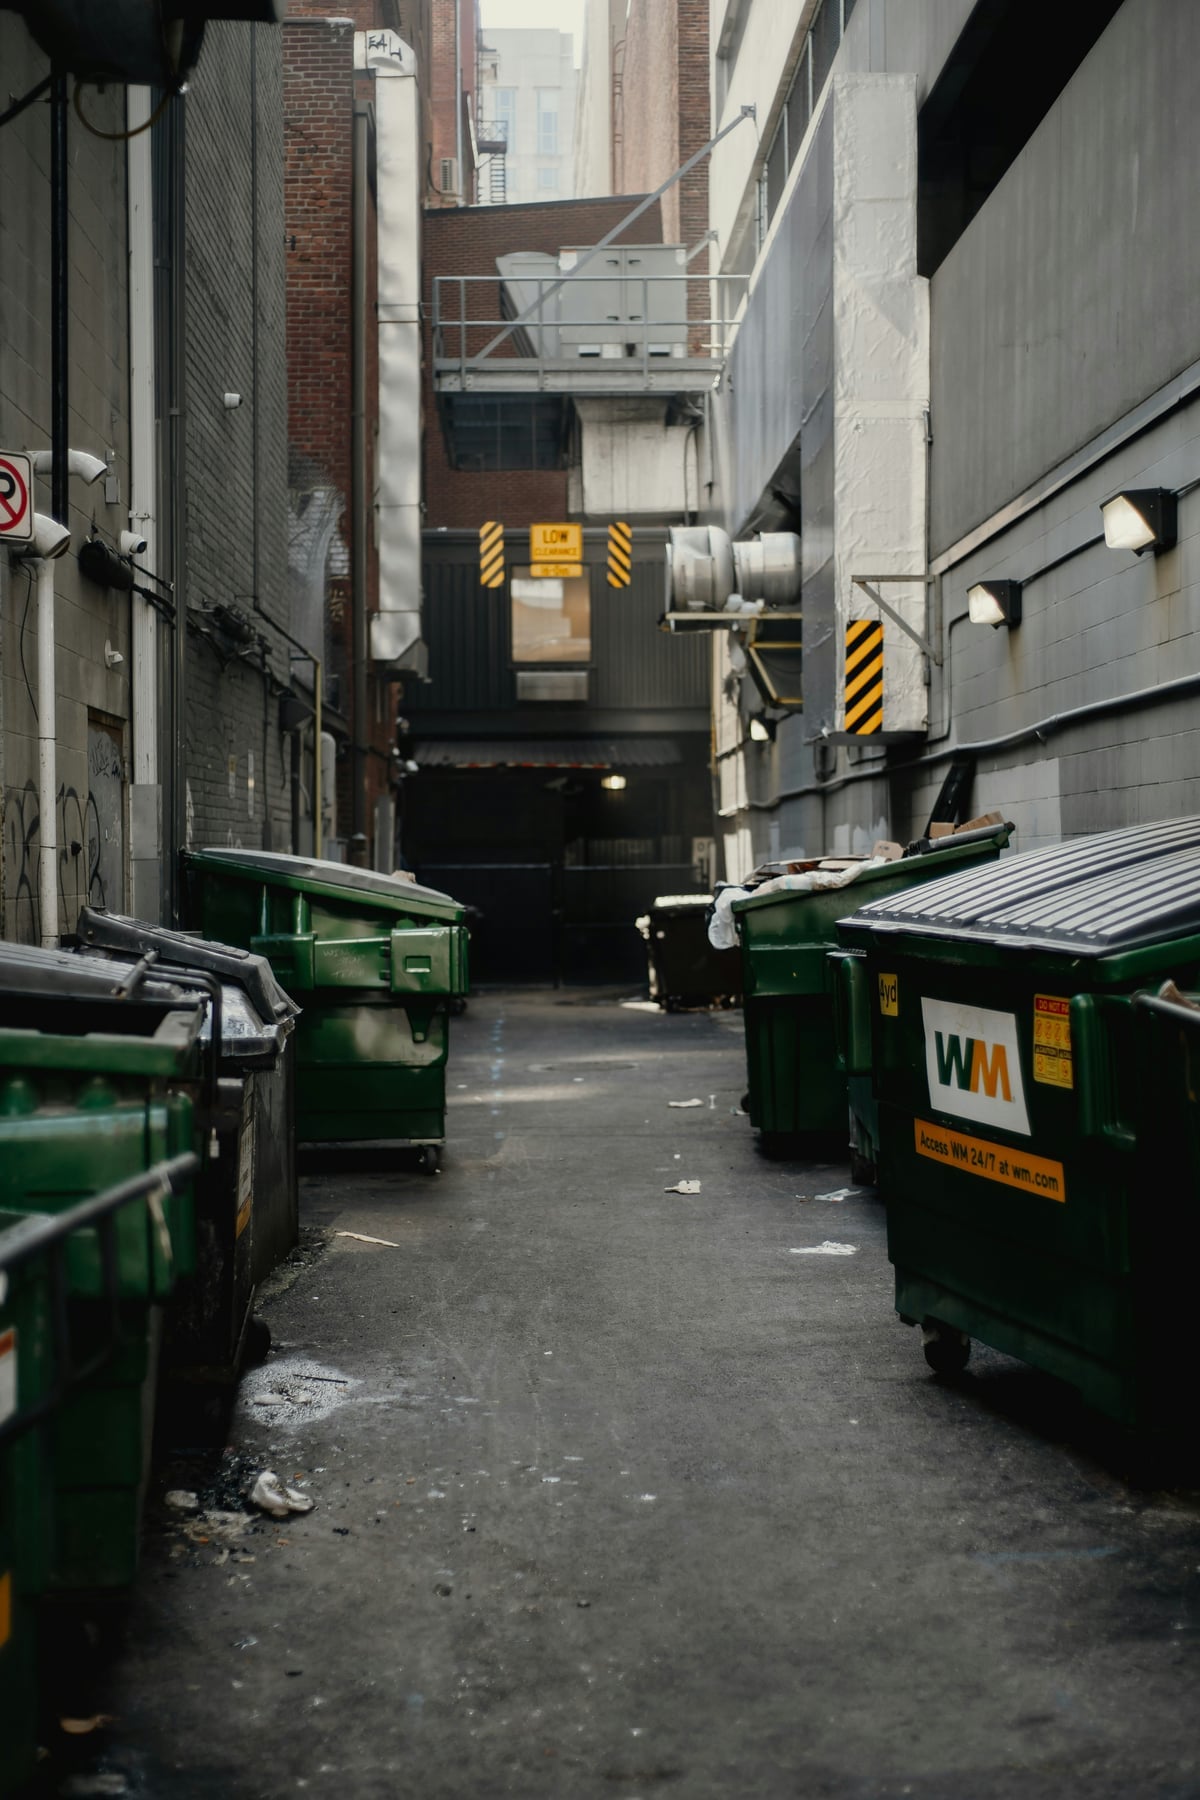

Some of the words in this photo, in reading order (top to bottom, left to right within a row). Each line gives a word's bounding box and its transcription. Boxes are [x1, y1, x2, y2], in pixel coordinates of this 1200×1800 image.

[542, 530, 569, 543] LOW
[934, 1031, 1012, 1102] WM
[920, 1130, 949, 1156] Access
[950, 1140, 968, 1163] WM
[970, 1147, 996, 1171] 24/7
[999, 1159, 1009, 1177] at
[1012, 1165, 1059, 1193] wm.com
